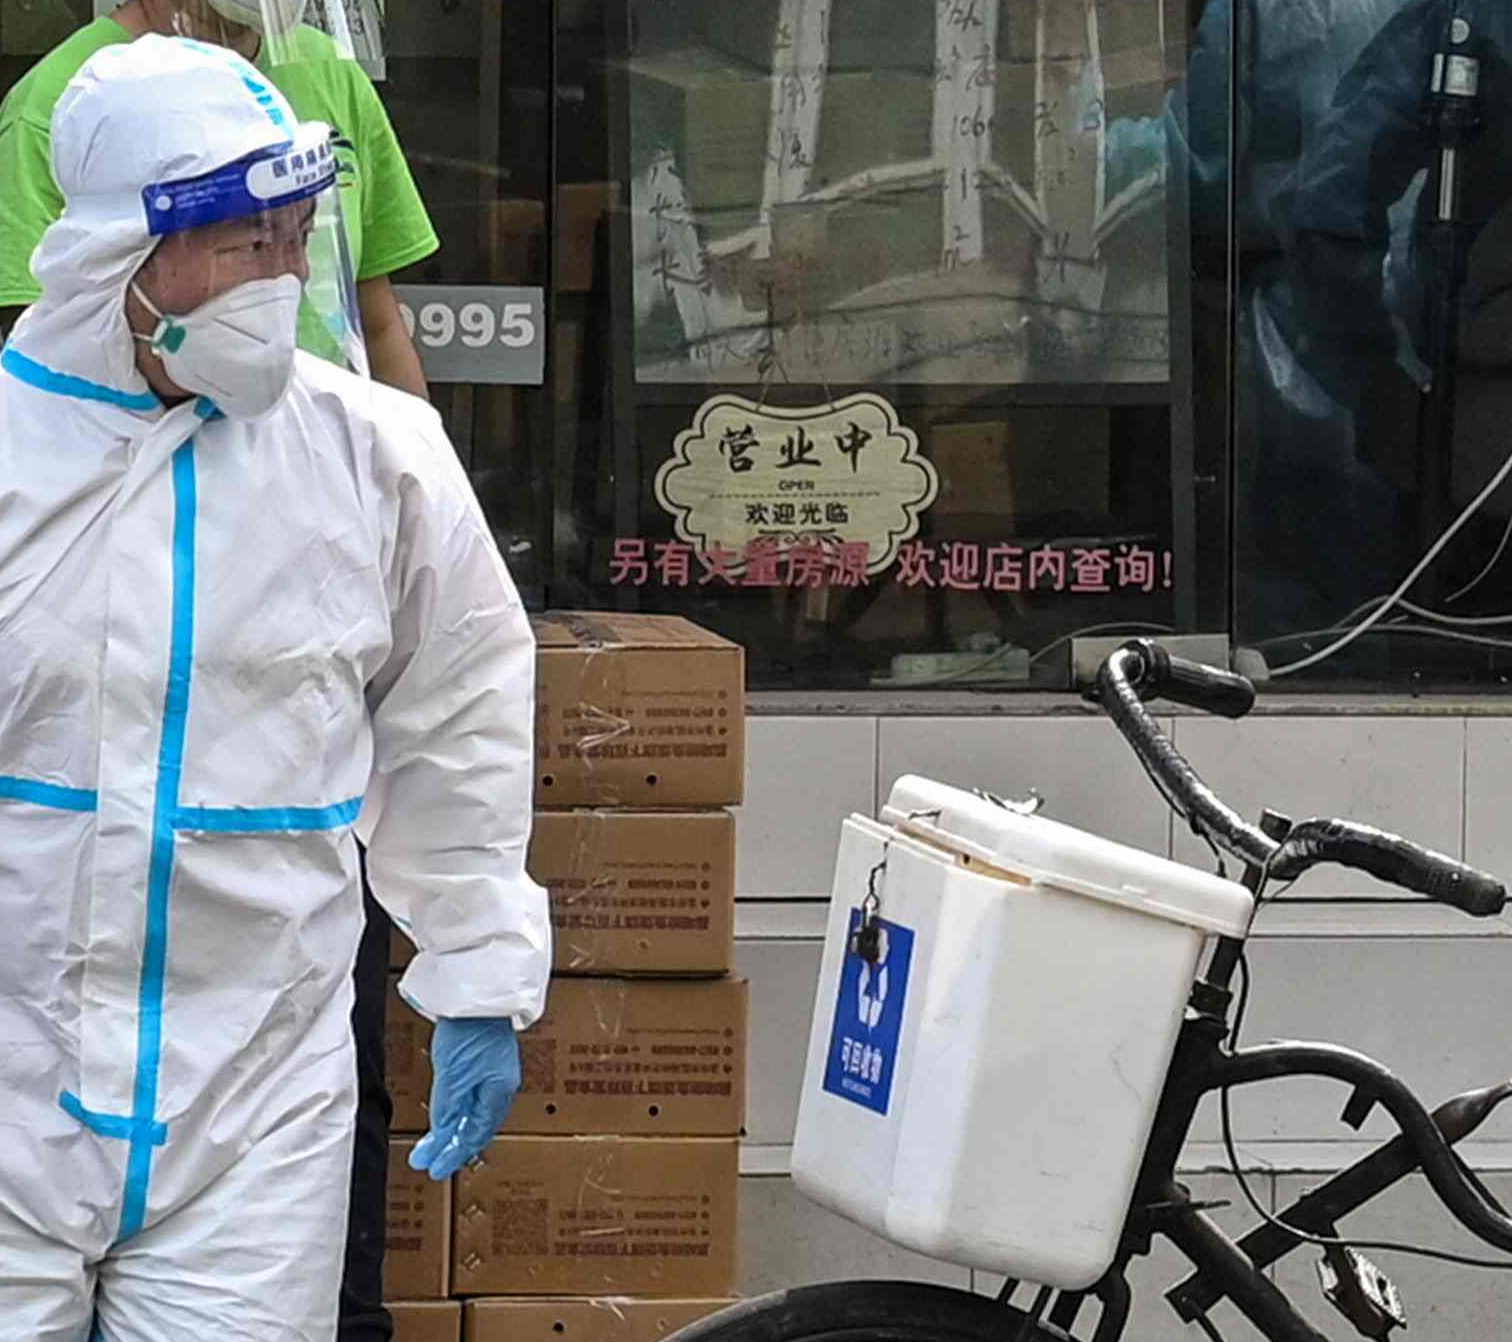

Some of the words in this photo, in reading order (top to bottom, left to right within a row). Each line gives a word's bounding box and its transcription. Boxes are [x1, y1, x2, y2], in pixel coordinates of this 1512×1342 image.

[718, 421, 872, 473] 营业中
[777, 479, 816, 491] OPEN
[745, 502, 849, 525] 欢迎光临
[608, 539, 871, 589] 另有大量房源
